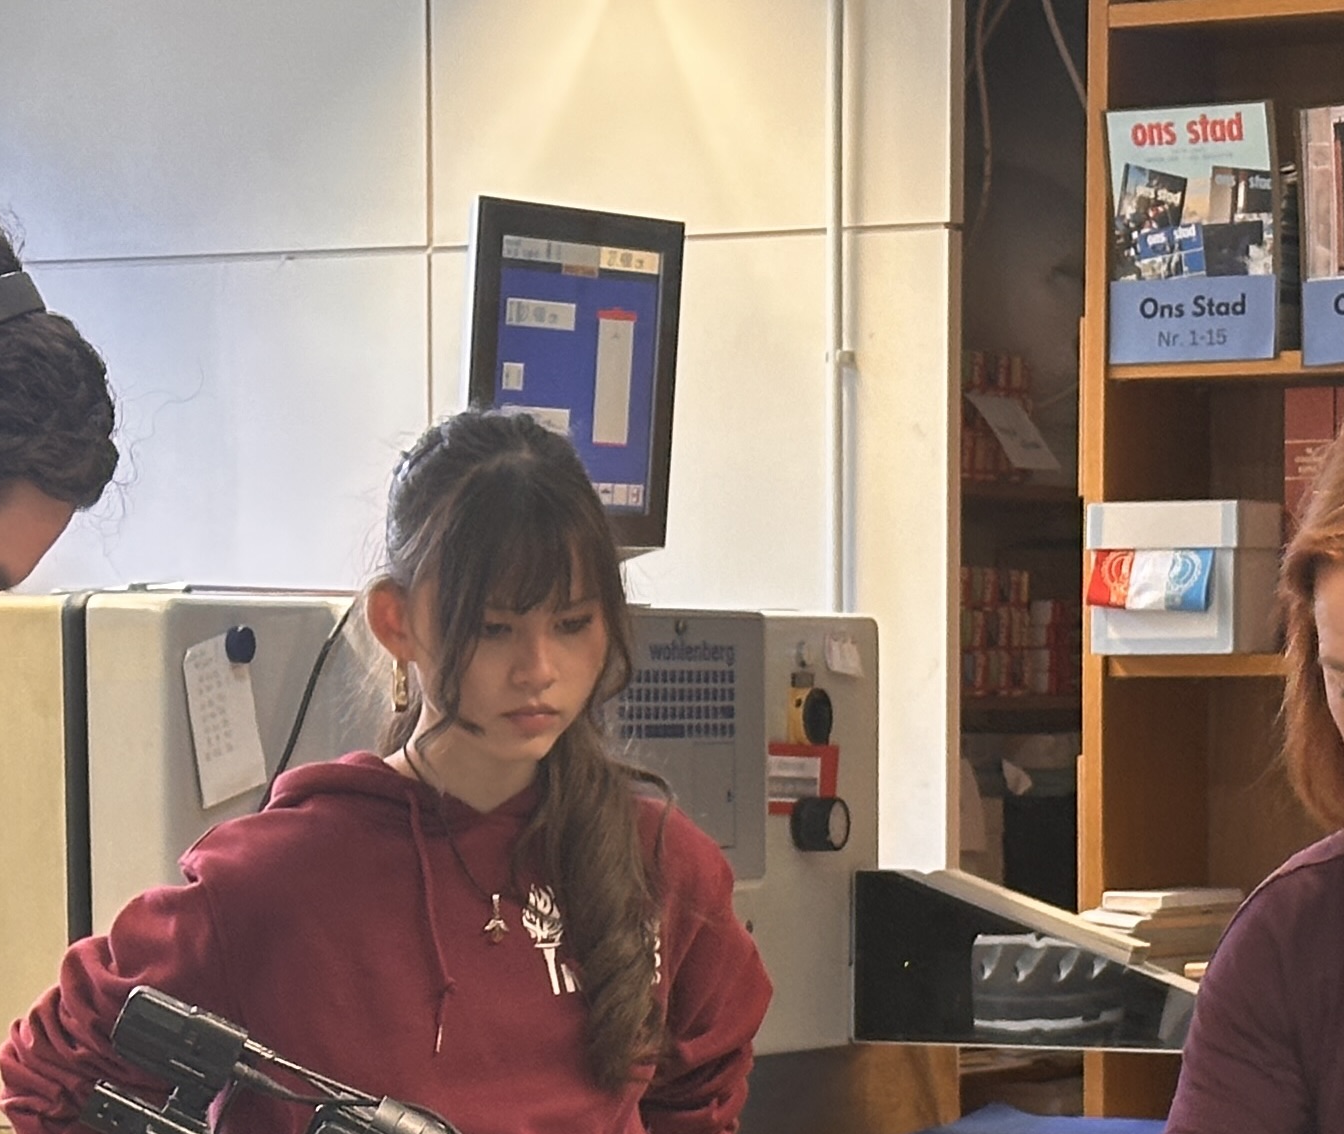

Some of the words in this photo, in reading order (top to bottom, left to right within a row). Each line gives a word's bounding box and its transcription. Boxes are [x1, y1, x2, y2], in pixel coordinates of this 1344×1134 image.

[1131, 121, 1177, 147] ons
[1186, 112, 1244, 145] stad
[1139, 297, 1186, 319] Ons
[1192, 294, 1247, 318] Stad
[1158, 330, 1183, 347] Nr.
[1190, 328, 1228, 347] 1-15
[649, 640, 735, 666] wohlenberg
